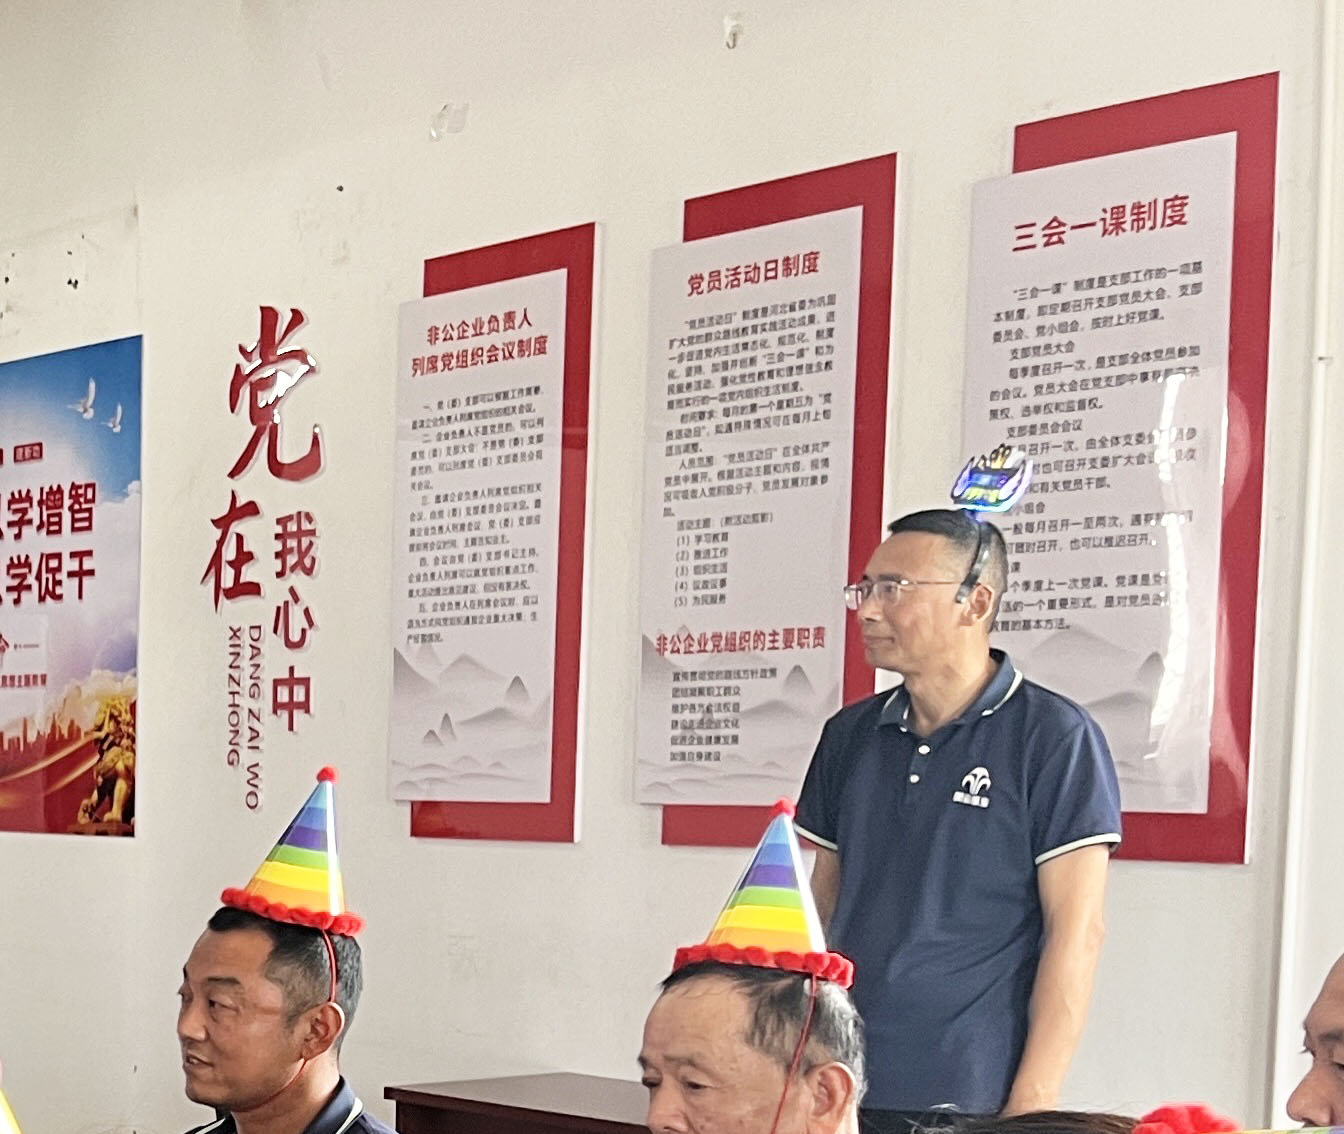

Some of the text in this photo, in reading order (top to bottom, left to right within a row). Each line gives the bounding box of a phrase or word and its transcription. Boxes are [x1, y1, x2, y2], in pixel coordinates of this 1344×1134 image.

[1012, 194, 1189, 252] 三会一课制度
[687, 251, 820, 297] 党员活动日制度
[427, 307, 533, 346] 非公企业负责人
[411, 334, 549, 378] 列席党组织会议制度
[1008, 341, 1075, 360] 支部党员大会
[272, 510, 317, 732] 我心中
[655, 627, 826, 656] 非公企业党组织的主要职责
[226, 625, 242, 768] XINZHONG
[245, 625, 263, 811] DANG ZAI WO
